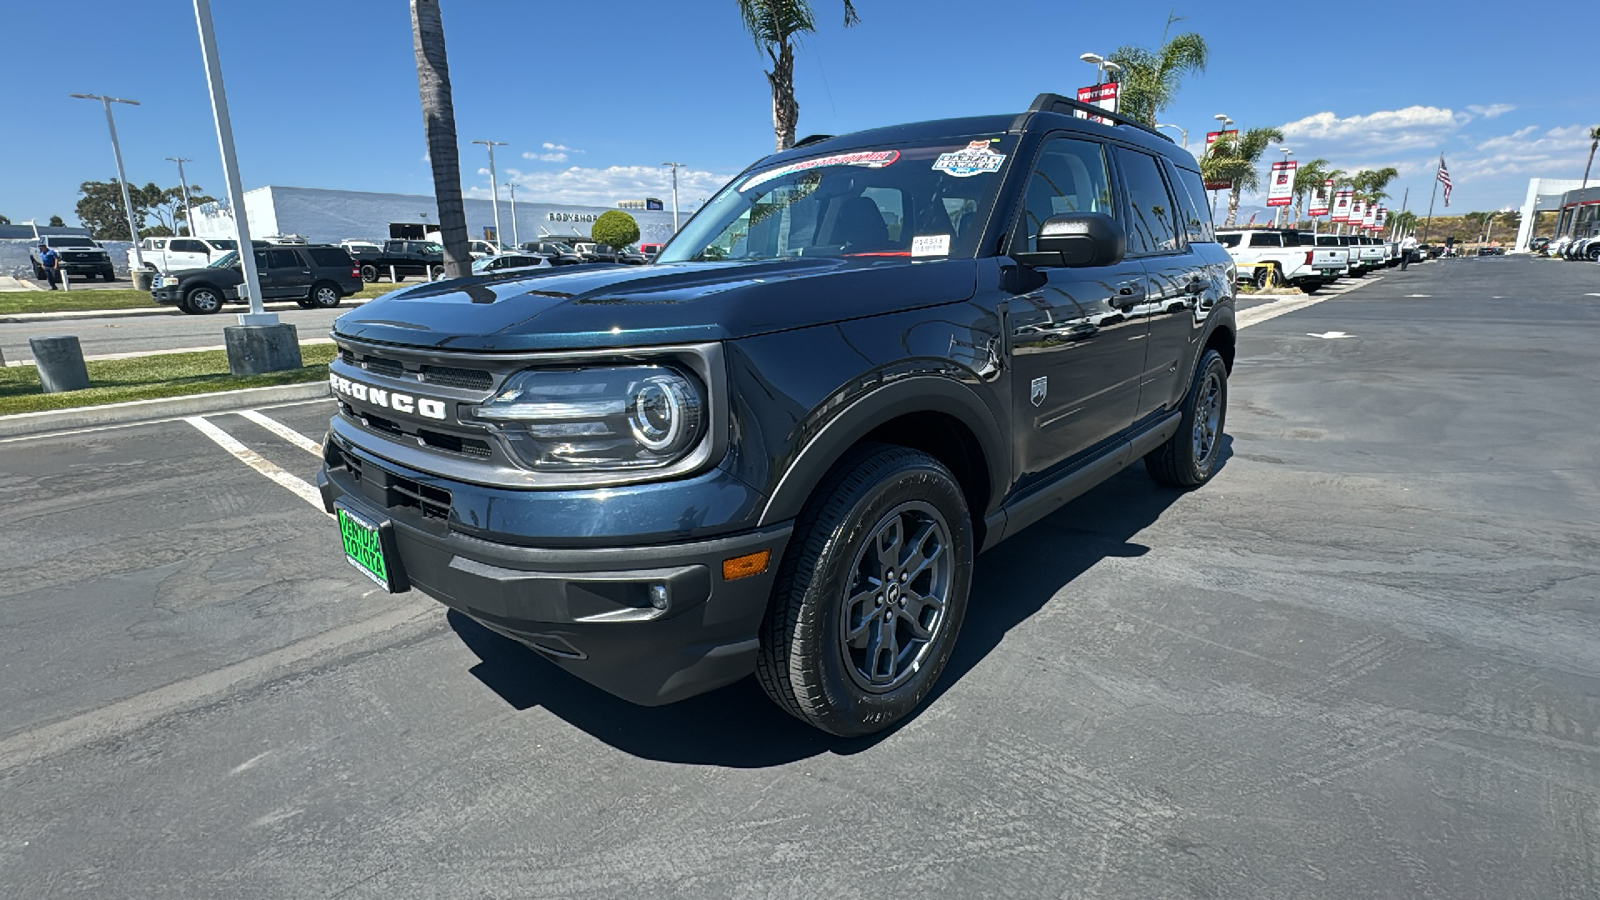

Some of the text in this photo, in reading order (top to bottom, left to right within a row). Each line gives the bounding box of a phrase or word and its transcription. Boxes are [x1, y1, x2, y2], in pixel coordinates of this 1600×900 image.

[1079, 88, 1115, 100] VENTURA
[330, 373, 446, 420] BRONCO
[340, 514, 380, 553] VENTURA
[345, 534, 384, 576] TOYOTA
